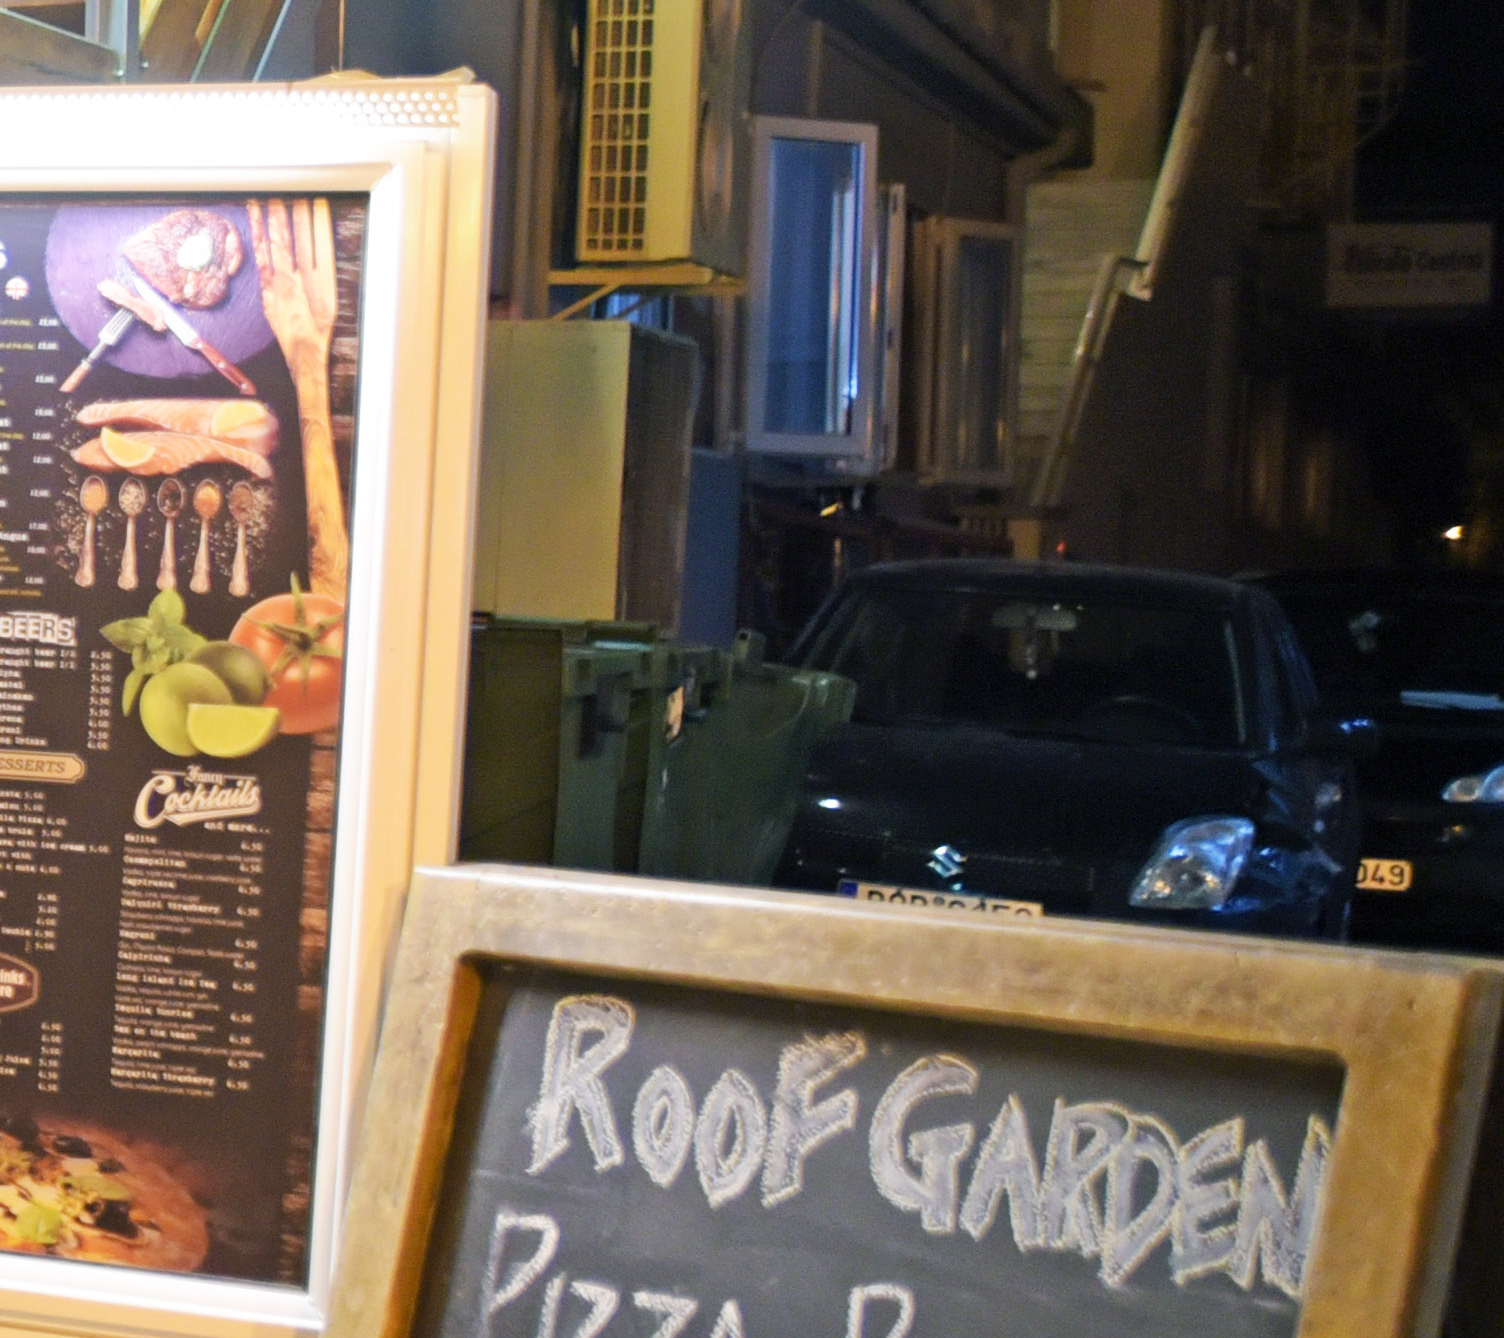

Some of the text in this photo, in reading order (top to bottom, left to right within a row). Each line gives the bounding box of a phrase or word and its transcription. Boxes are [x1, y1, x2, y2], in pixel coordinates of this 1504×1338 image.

[134, 773, 261, 828] Cocktails
[185, 764, 224, 787] Fancy
[526, 993, 1338, 1301] ROOF GARDEN
